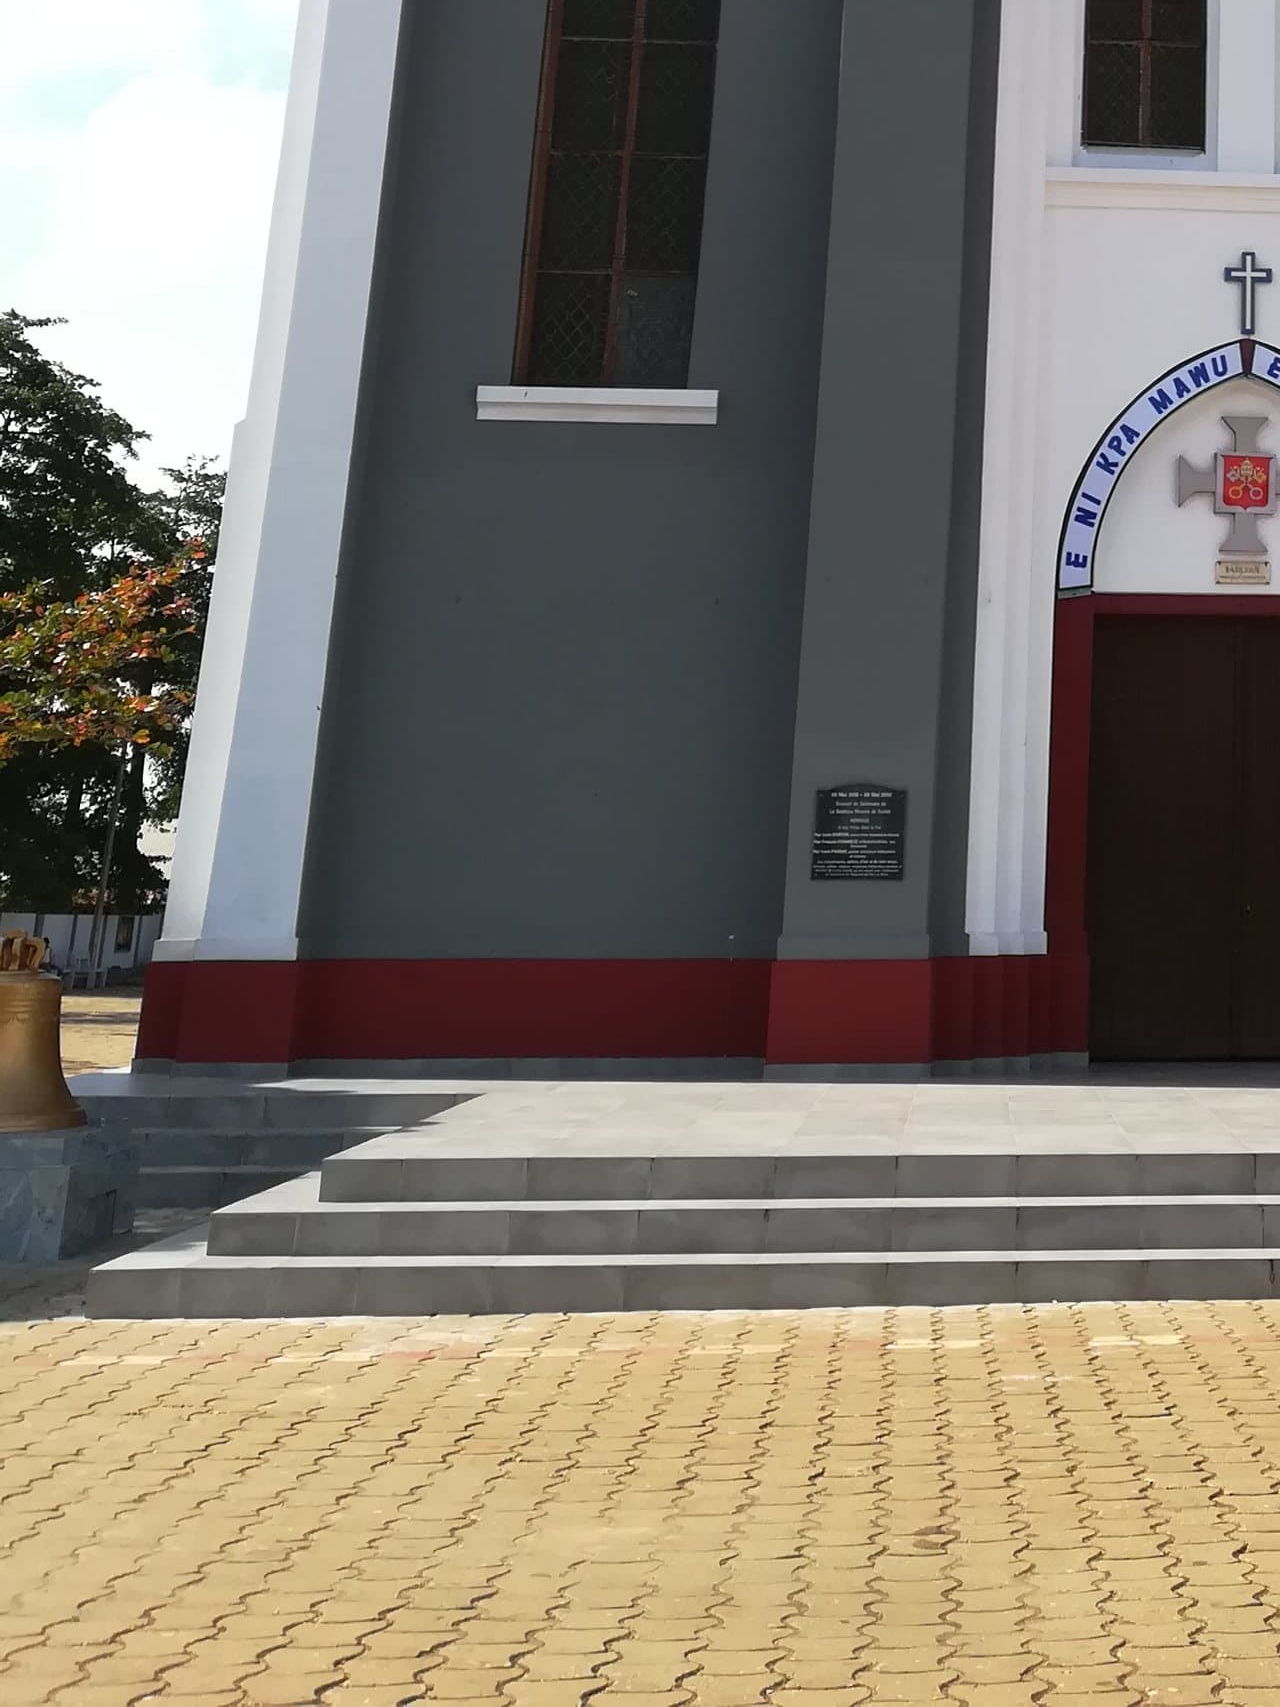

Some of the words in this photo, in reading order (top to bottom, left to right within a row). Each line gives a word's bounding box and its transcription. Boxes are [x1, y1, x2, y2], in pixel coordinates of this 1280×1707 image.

[1147, 354, 1228, 415] MAWU
[1095, 423, 1141, 476] KPA
[1073, 491, 1102, 528] NI
[1064, 551, 1088, 569] E
